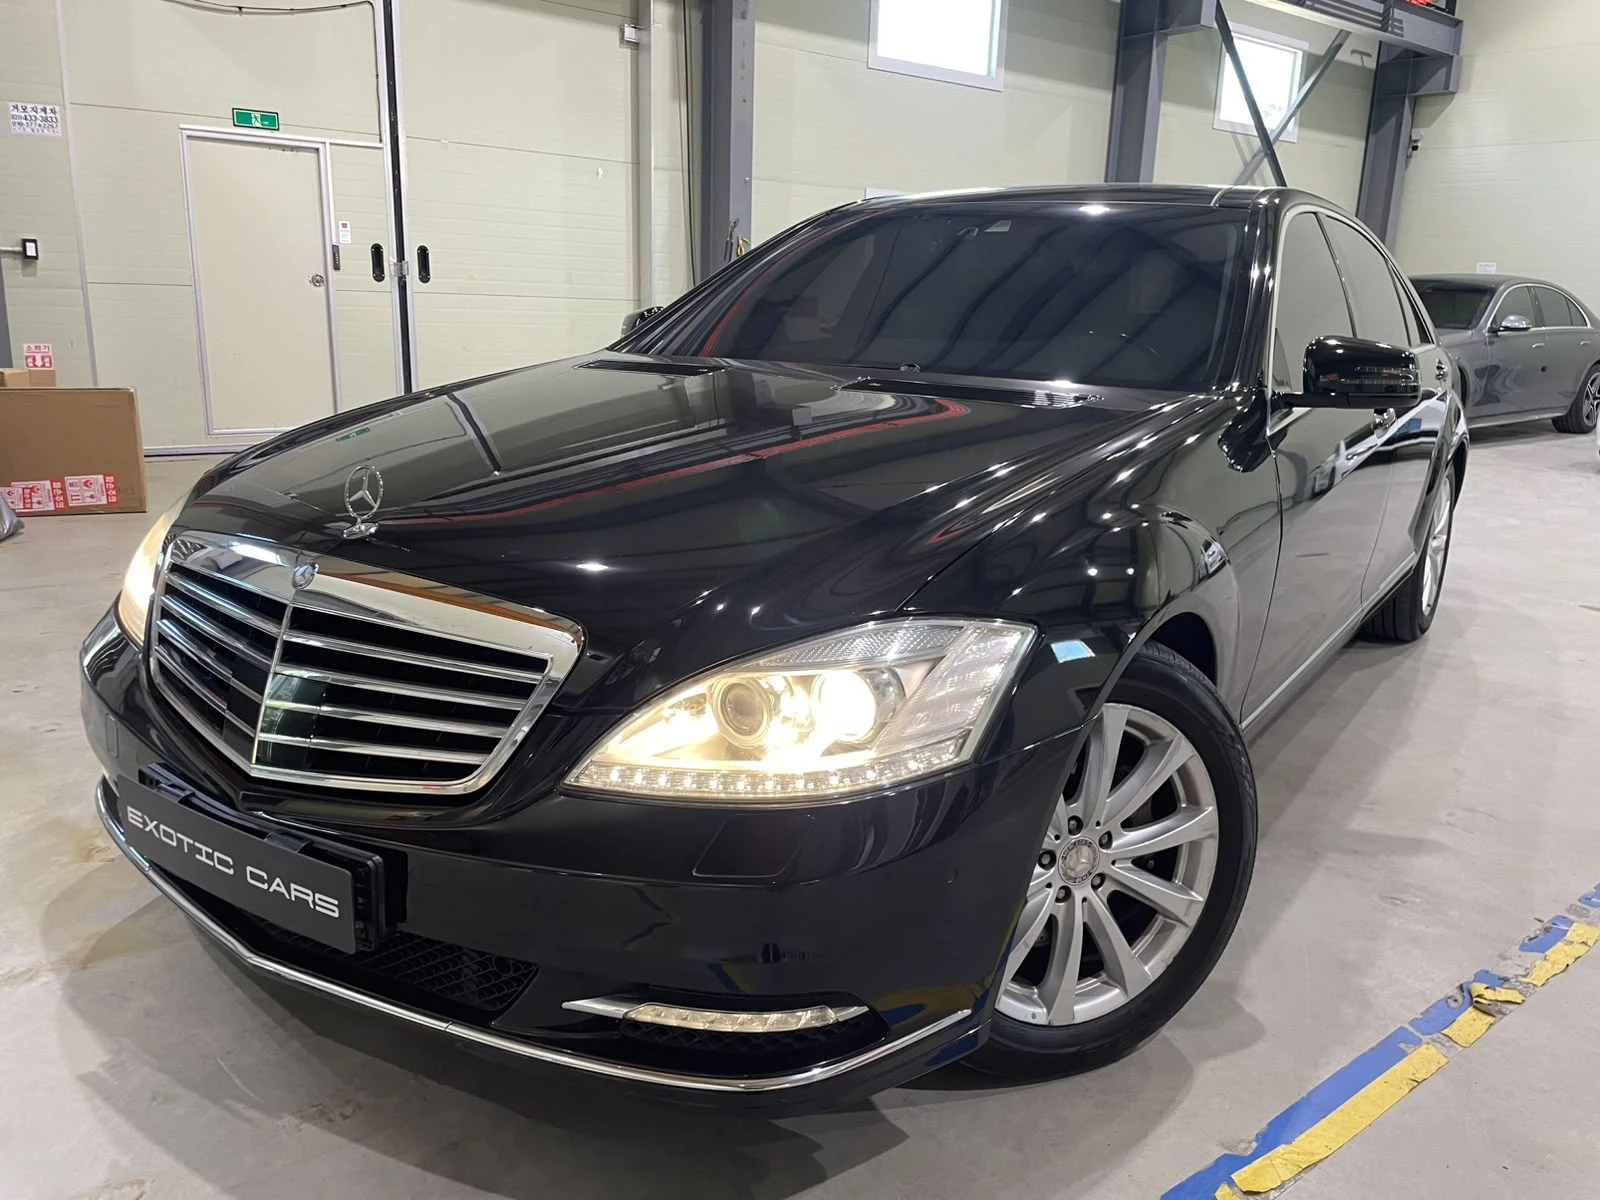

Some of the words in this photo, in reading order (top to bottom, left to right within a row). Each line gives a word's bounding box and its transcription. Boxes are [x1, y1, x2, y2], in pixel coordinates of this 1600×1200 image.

[52, 481, 65, 508] 파손주의
[105, 475, 117, 502] 파손주의
[127, 805, 234, 875] EXOTIC
[246, 865, 340, 918] CARS
